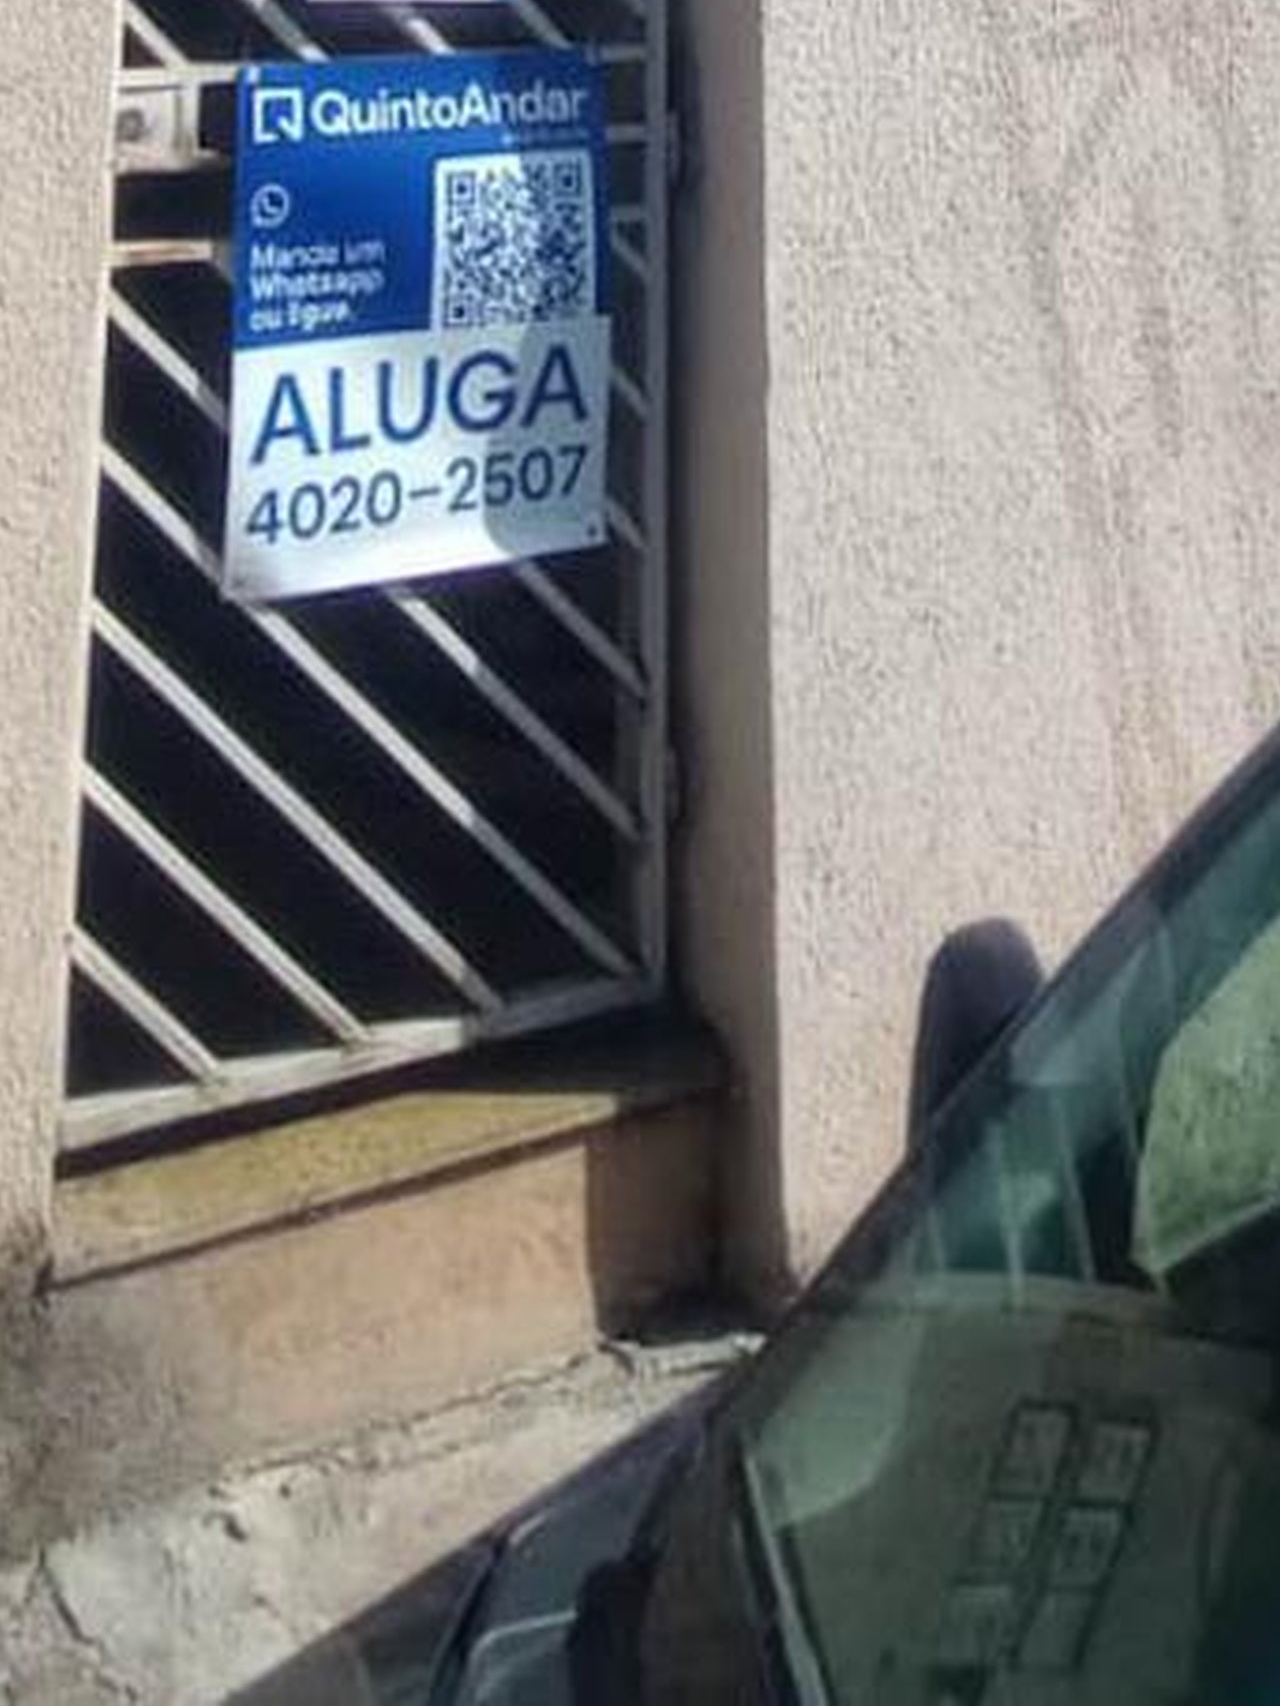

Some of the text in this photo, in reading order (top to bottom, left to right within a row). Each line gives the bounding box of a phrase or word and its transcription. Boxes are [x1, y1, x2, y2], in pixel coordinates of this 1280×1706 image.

[310, 78, 588, 135] QuintoAndar
[250, 343, 589, 466] ALUGA
[246, 443, 589, 547] 4020-2507
